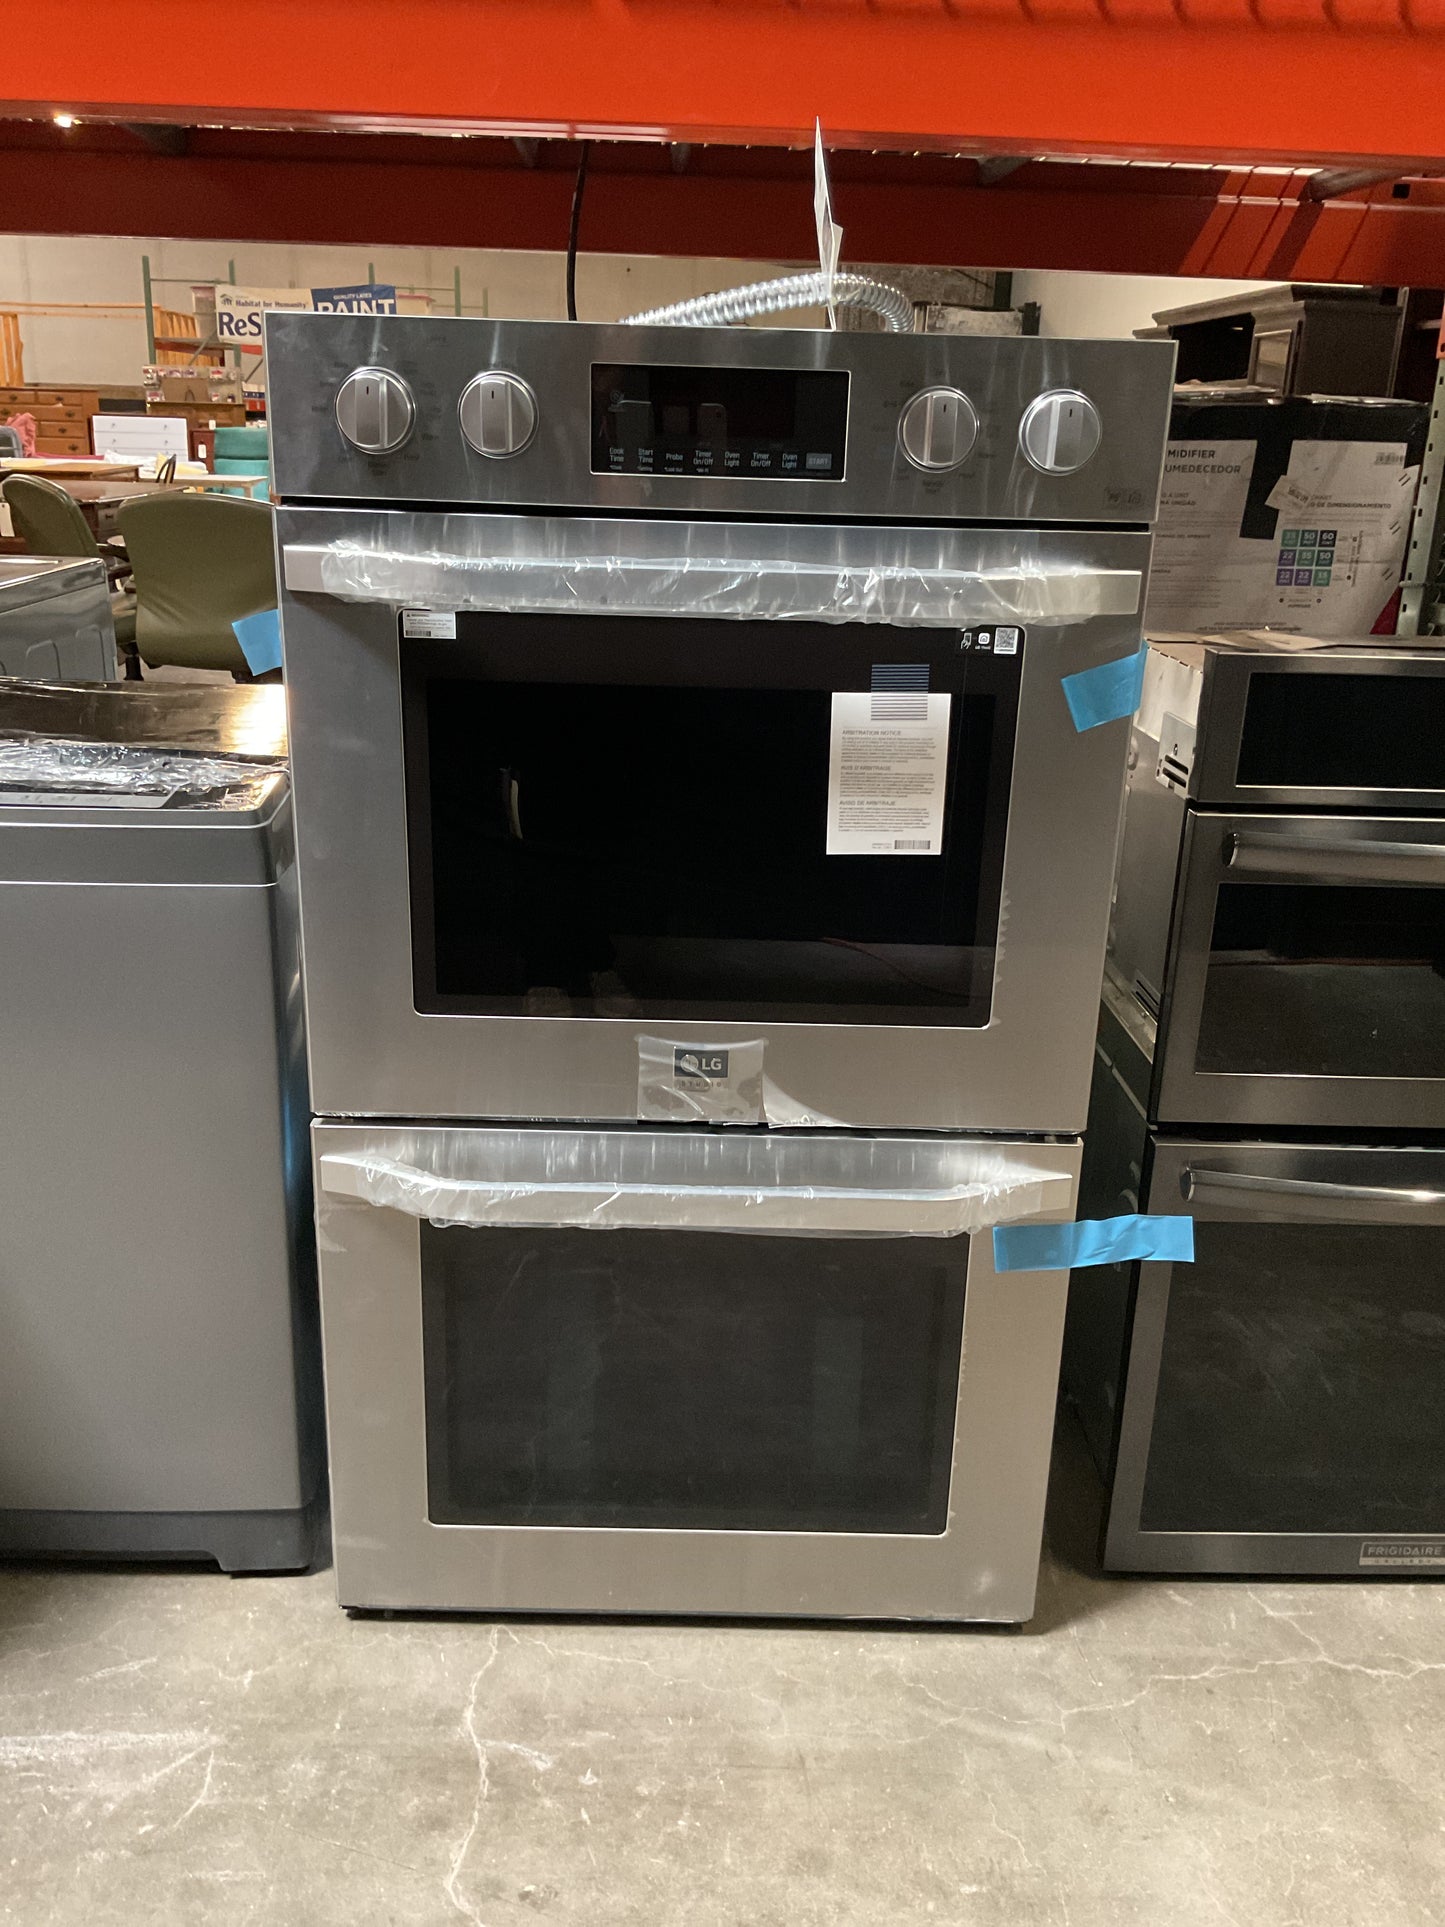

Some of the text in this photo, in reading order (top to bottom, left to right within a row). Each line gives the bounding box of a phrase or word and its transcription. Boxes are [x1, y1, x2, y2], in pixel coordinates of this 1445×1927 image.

[263, 300, 273, 308] for
[274, 301, 306, 310] Humanity
[609, 447, 624, 455] Cook
[638, 448, 653, 456] Start
[724, 451, 740, 459] Oven
[666, 453, 683, 461] Probe
[724, 459, 740, 467] Light
[782, 461, 797, 469] Light
[701, 1058, 722, 1070] LG
[1368, 1546, 1442, 1555] FRIGIDAIRE
